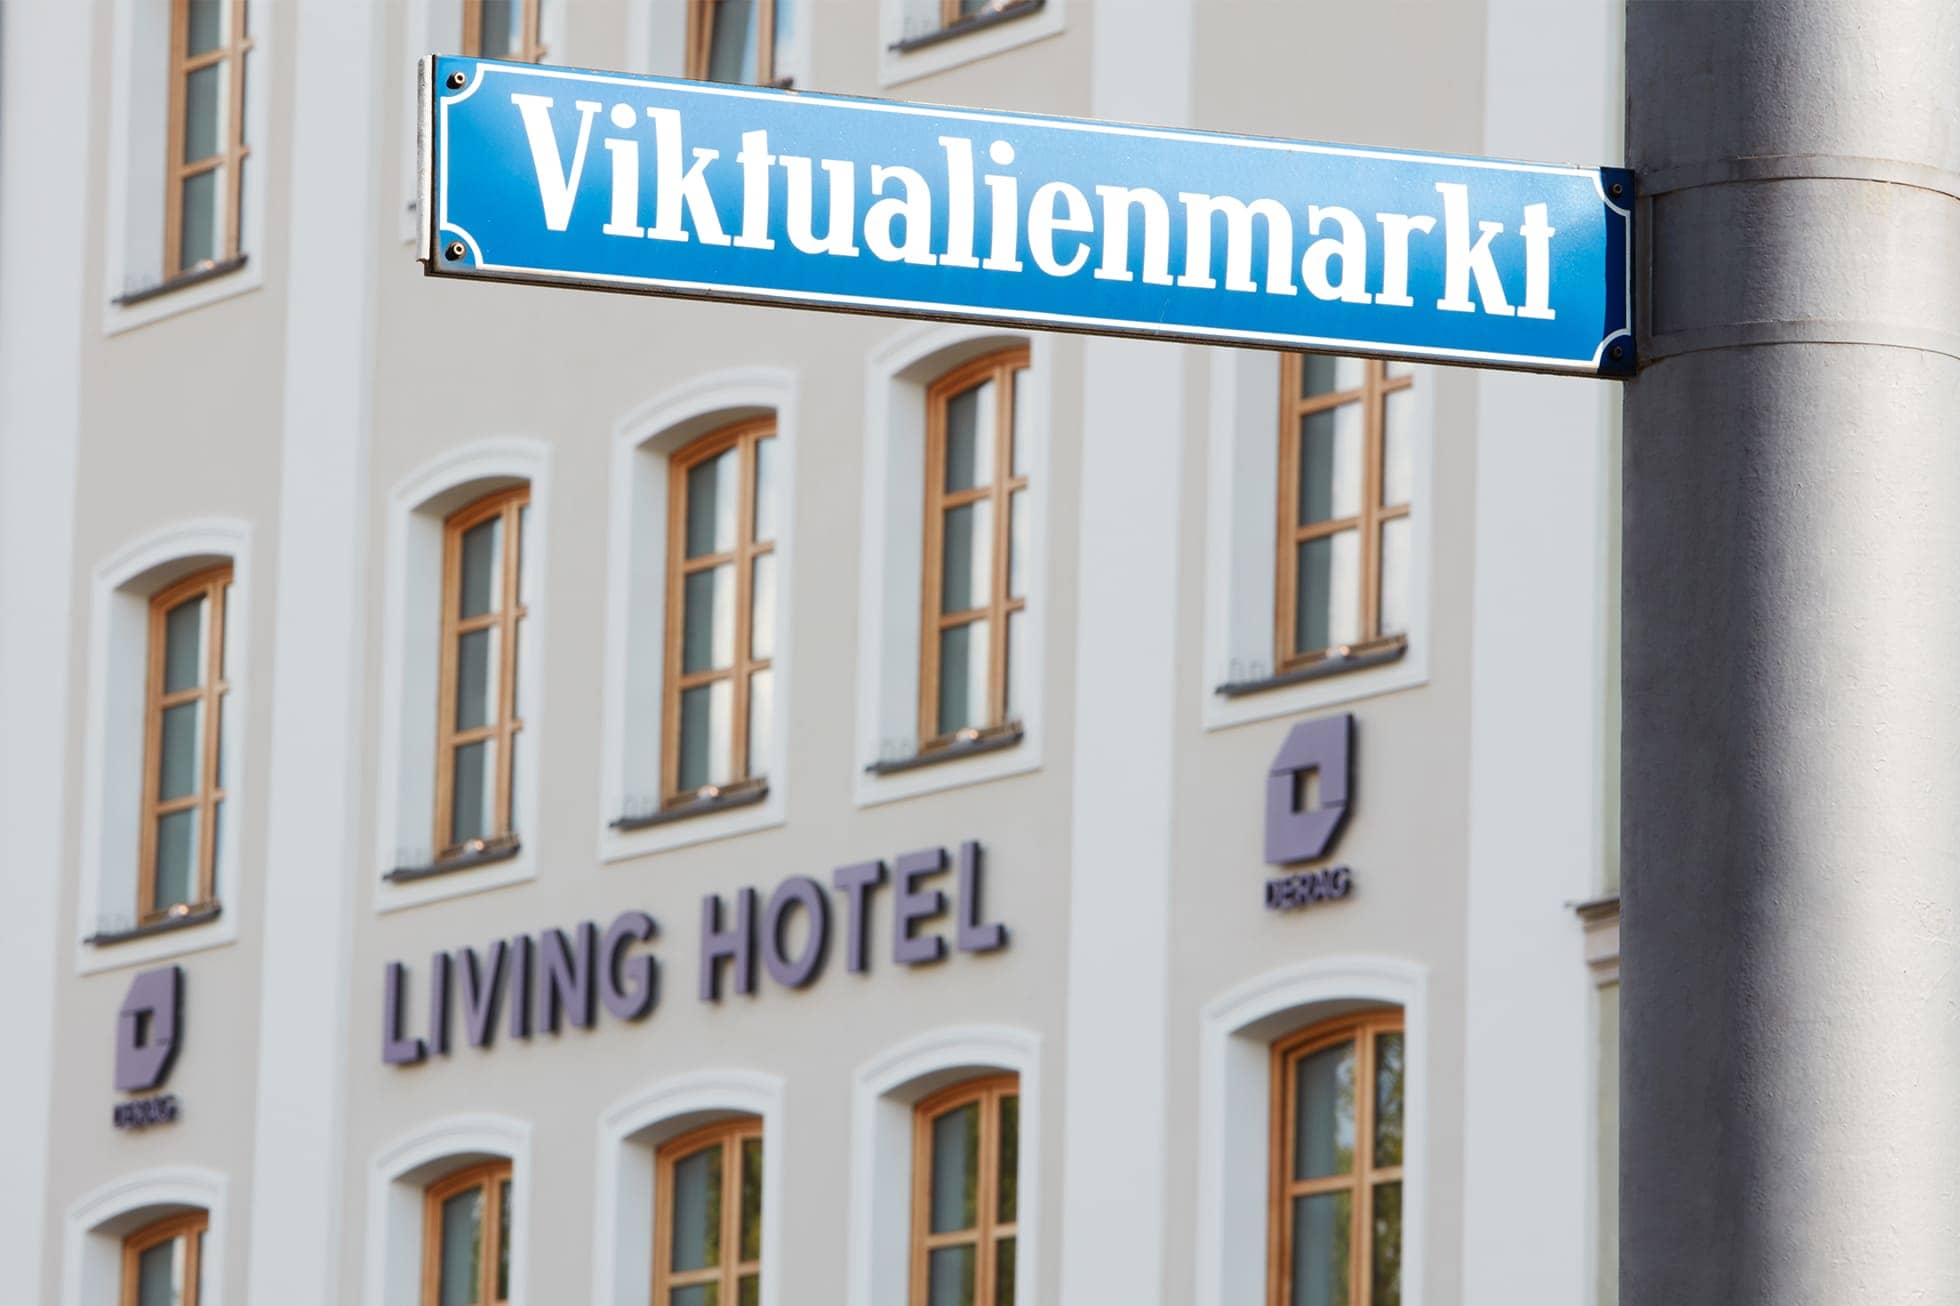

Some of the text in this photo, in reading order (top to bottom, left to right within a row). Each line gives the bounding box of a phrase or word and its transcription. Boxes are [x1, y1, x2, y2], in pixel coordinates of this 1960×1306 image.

[511, 93, 1556, 320] Viktualienmarkt
[382, 840, 1007, 1066] LIVING HOTEL
[1265, 867, 1352, 910] DERAG
